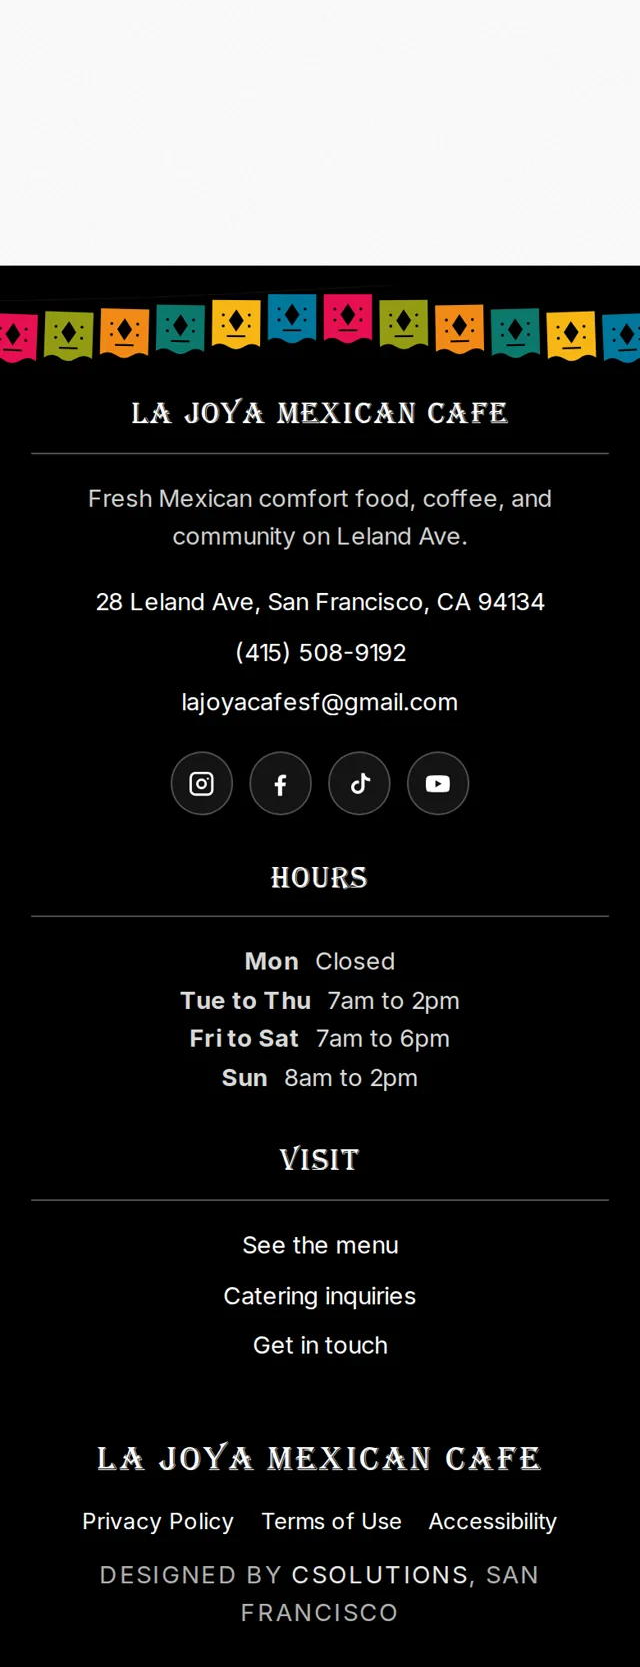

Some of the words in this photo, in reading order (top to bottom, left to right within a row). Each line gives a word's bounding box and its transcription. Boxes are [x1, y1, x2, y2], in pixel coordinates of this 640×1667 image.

[132, 402, 172, 423] LA
[184, 397, 265, 423] JOYA
[277, 402, 416, 424] MEXICAN
[428, 402, 508, 424] CAFE
[96, 593, 122, 611] 28
[131, 593, 204, 611] Leland
[212, 593, 260, 615] Ave,
[268, 593, 308, 611] San
[316, 592, 429, 615] Francisco,
[437, 593, 471, 611] CA
[478, 593, 545, 611] 94134
[237, 641, 289, 664] (415)
[300, 644, 406, 661] 508-9192
[183, 692, 457, 716] lajoyacafesf@gmail.com
[271, 867, 367, 890] HOURS
[246, 952, 298, 970] Mon
[316, 952, 394, 970] Closed
[222, 1069, 267, 1086] Sun
[285, 1069, 332, 1086] 8am
[340, 1069, 362, 1086] to
[371, 1069, 417, 1091] 2pm
[279, 1145, 360, 1170] VISIT
[243, 1236, 285, 1254] See
[293, 1236, 328, 1254] the
[337, 1240, 398, 1254] menu
[224, 1286, 317, 1310] Catering
[326, 1286, 416, 1310] inquiries
[254, 1336, 293, 1354] Get
[301, 1336, 318, 1354] in
[325, 1336, 387, 1354] touch
[97, 1447, 145, 1470] LA
[158, 1441, 254, 1470] JOYA
[267, 1447, 431, 1470] MEXICAN
[446, 1447, 542, 1470] CAFE
[83, 1512, 162, 1534] Privacy
[170, 1512, 234, 1534] Policy
[262, 1512, 325, 1530] Terms
[332, 1512, 355, 1529] of
[362, 1512, 402, 1529] Use
[429, 1512, 557, 1534] Accessibility
[101, 1566, 235, 1584] DESIGNED
[248, 1566, 281, 1584] BY
[292, 1566, 474, 1588] CSOLUTIONS,
[487, 1566, 537, 1584] SAN
[242, 1604, 396, 1621] FRANCISCO
